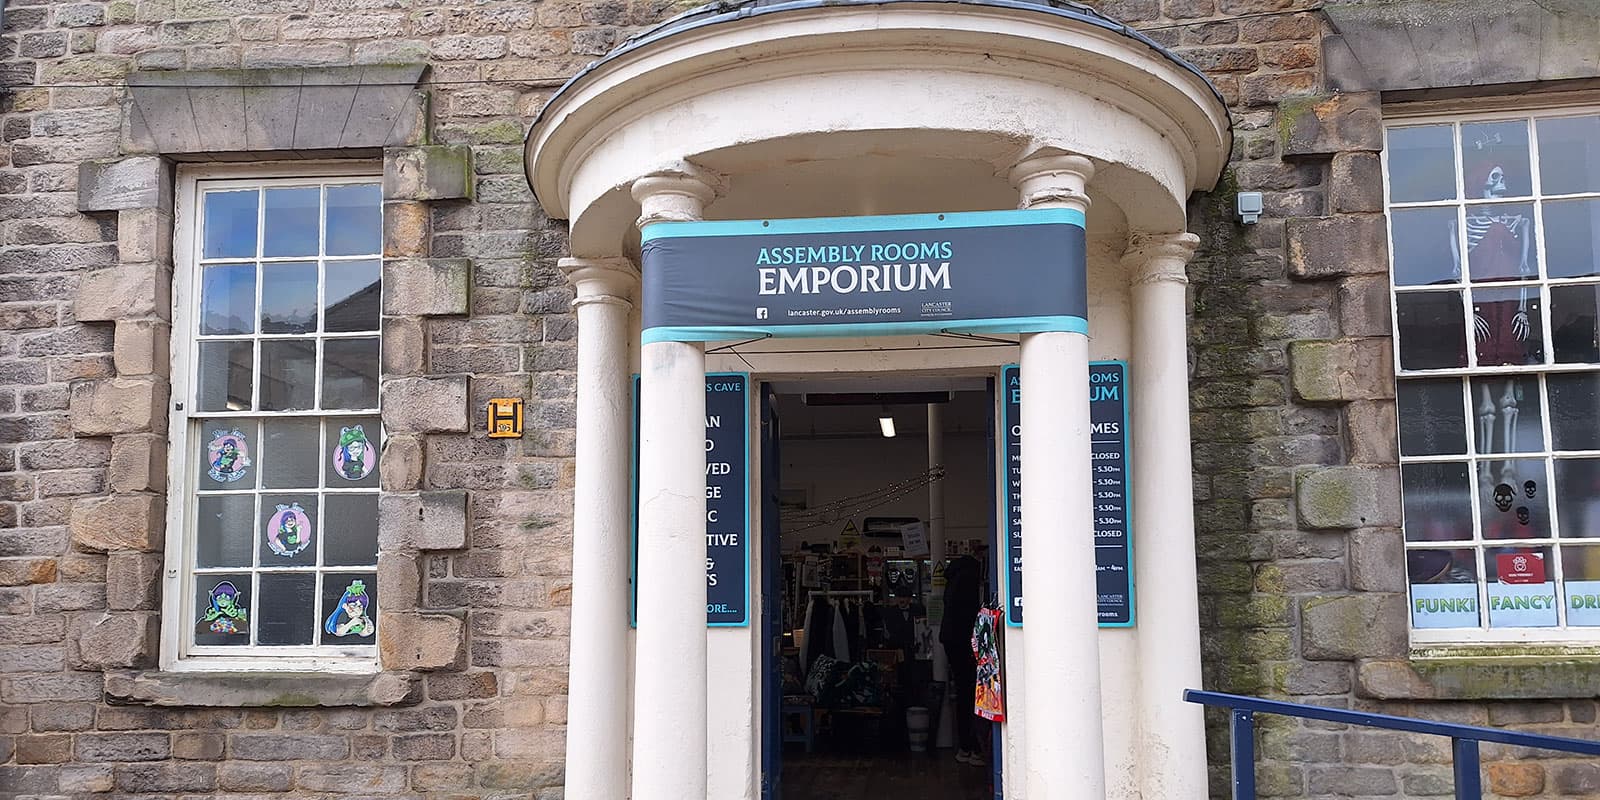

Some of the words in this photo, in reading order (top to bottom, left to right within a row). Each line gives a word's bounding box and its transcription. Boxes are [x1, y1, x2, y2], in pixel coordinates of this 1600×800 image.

[756, 245, 865, 265] ASSEMBLY
[871, 241, 953, 261] ROOMS
[758, 262, 952, 295] EMPORIUM
[787, 307, 901, 317] lancaster.gov.uk/assemblyrooms
[1089, 372, 1120, 383] OMS
[714, 383, 741, 391] CAVE
[492, 402, 518, 433] H
[1091, 422, 1120, 434] MES
[706, 534, 738, 546] TIVE
[705, 603, 738, 613] ORE....
[1415, 597, 1476, 613] FUNKI
[1490, 594, 1554, 610] FANCY
